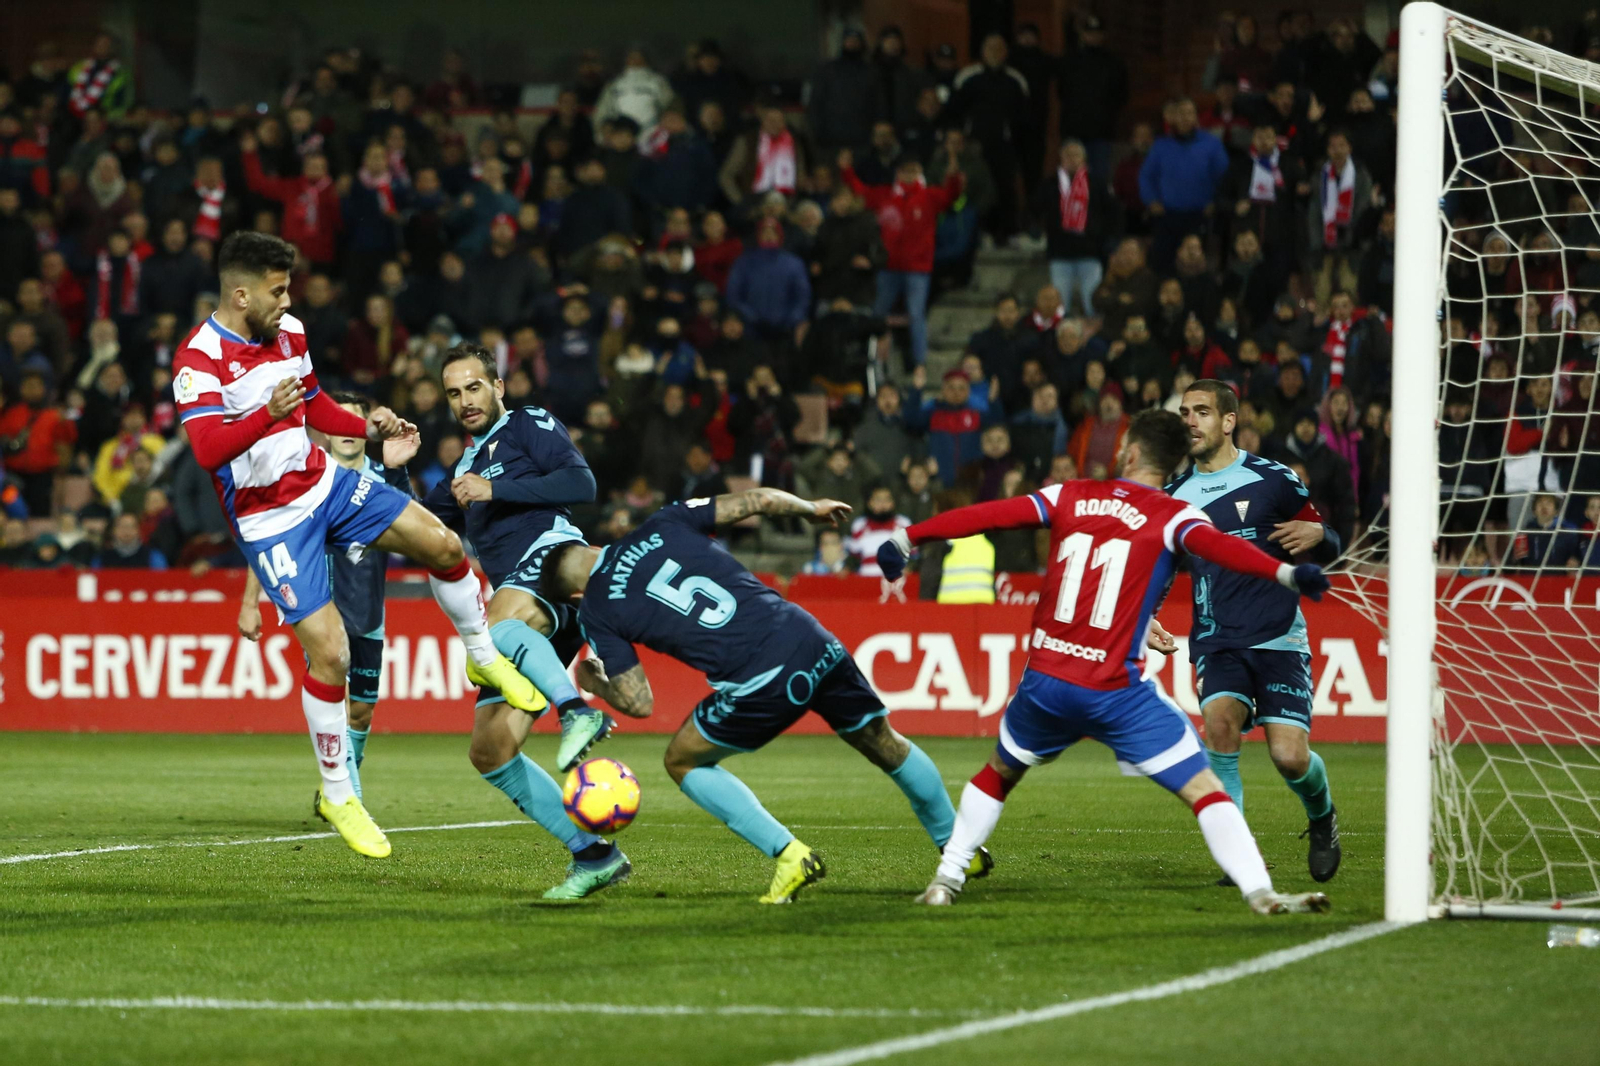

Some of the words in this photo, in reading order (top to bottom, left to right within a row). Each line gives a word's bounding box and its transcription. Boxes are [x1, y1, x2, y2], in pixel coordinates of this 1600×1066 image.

[1074, 498, 1148, 531] RODRIGO
[1201, 482, 1227, 494] hummel
[258, 542, 298, 588] 14
[1054, 532, 1131, 630] 11
[645, 558, 737, 629] 5
[26, 633, 293, 700] CERVEZAS
